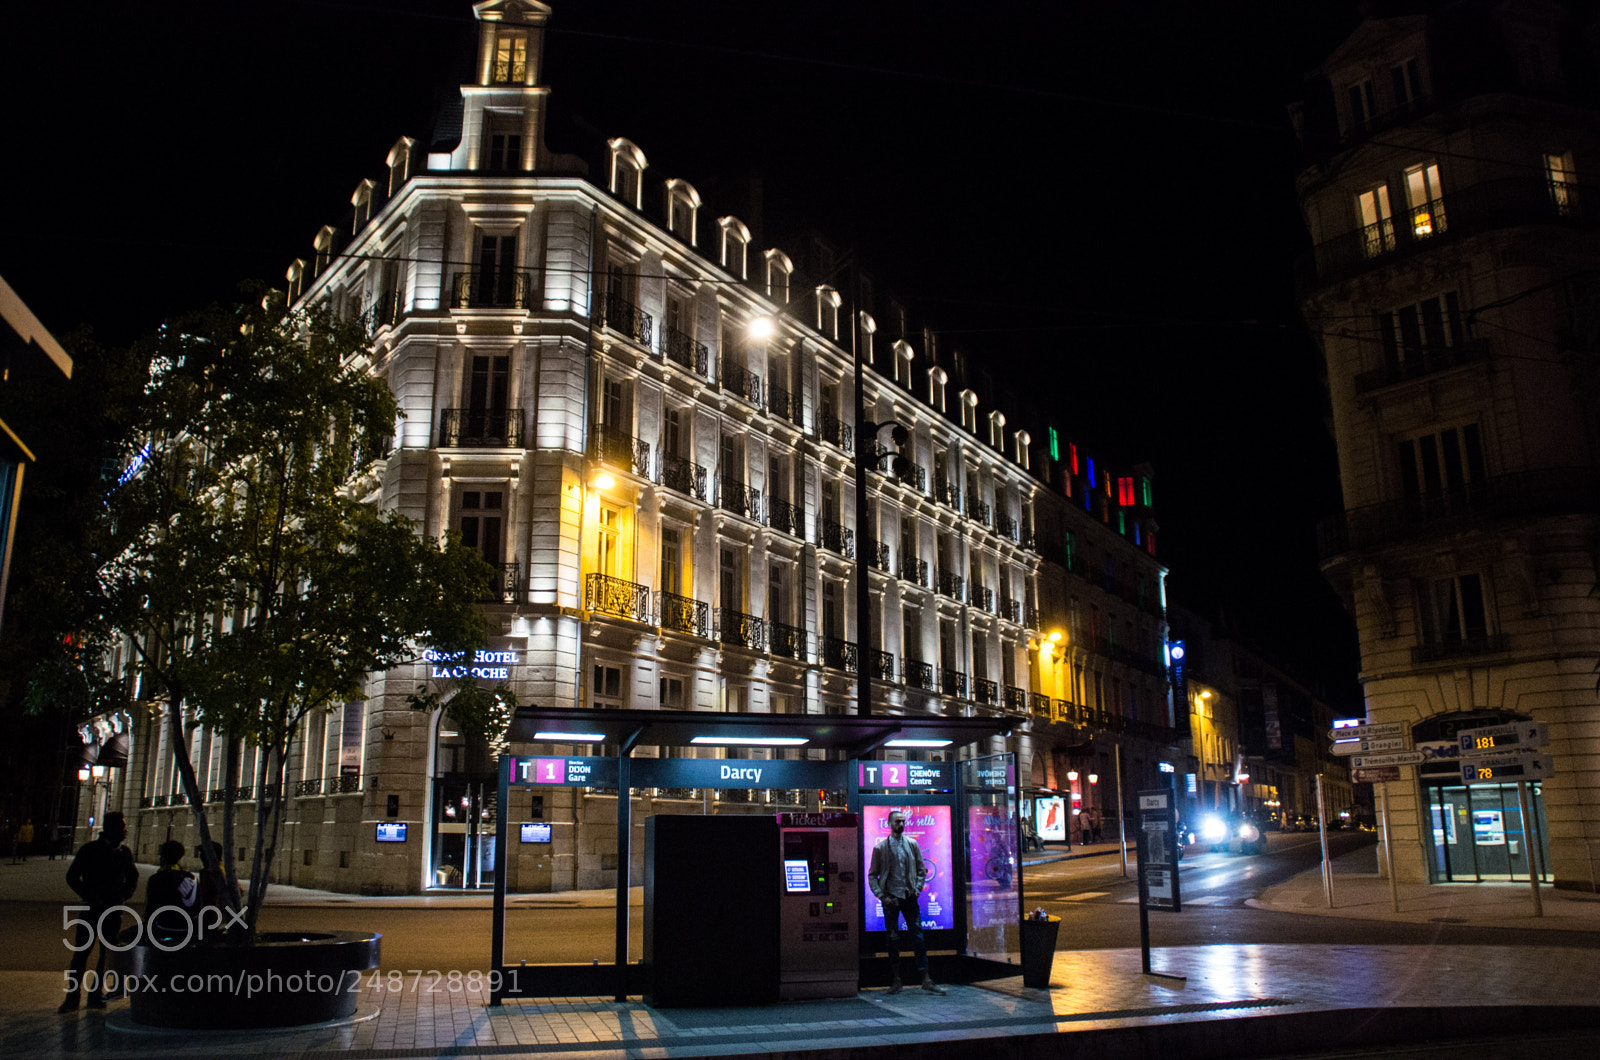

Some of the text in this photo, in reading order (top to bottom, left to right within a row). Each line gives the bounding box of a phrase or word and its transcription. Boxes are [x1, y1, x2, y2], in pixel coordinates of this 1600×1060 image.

[473, 649, 520, 663] HOTEL
[432, 666, 451, 678] LA
[1335, 730, 1351, 738] Place
[1475, 736, 1495, 749] 181
[519, 761, 555, 779] T 1
[568, 766, 591, 774] DIJON
[720, 765, 762, 783] Darcy
[866, 767, 899, 783] T 2
[1477, 767, 1493, 779] 78
[568, 774, 586, 782] Gare
[910, 777, 932, 785] Centre
[789, 812, 827, 825] Tickets
